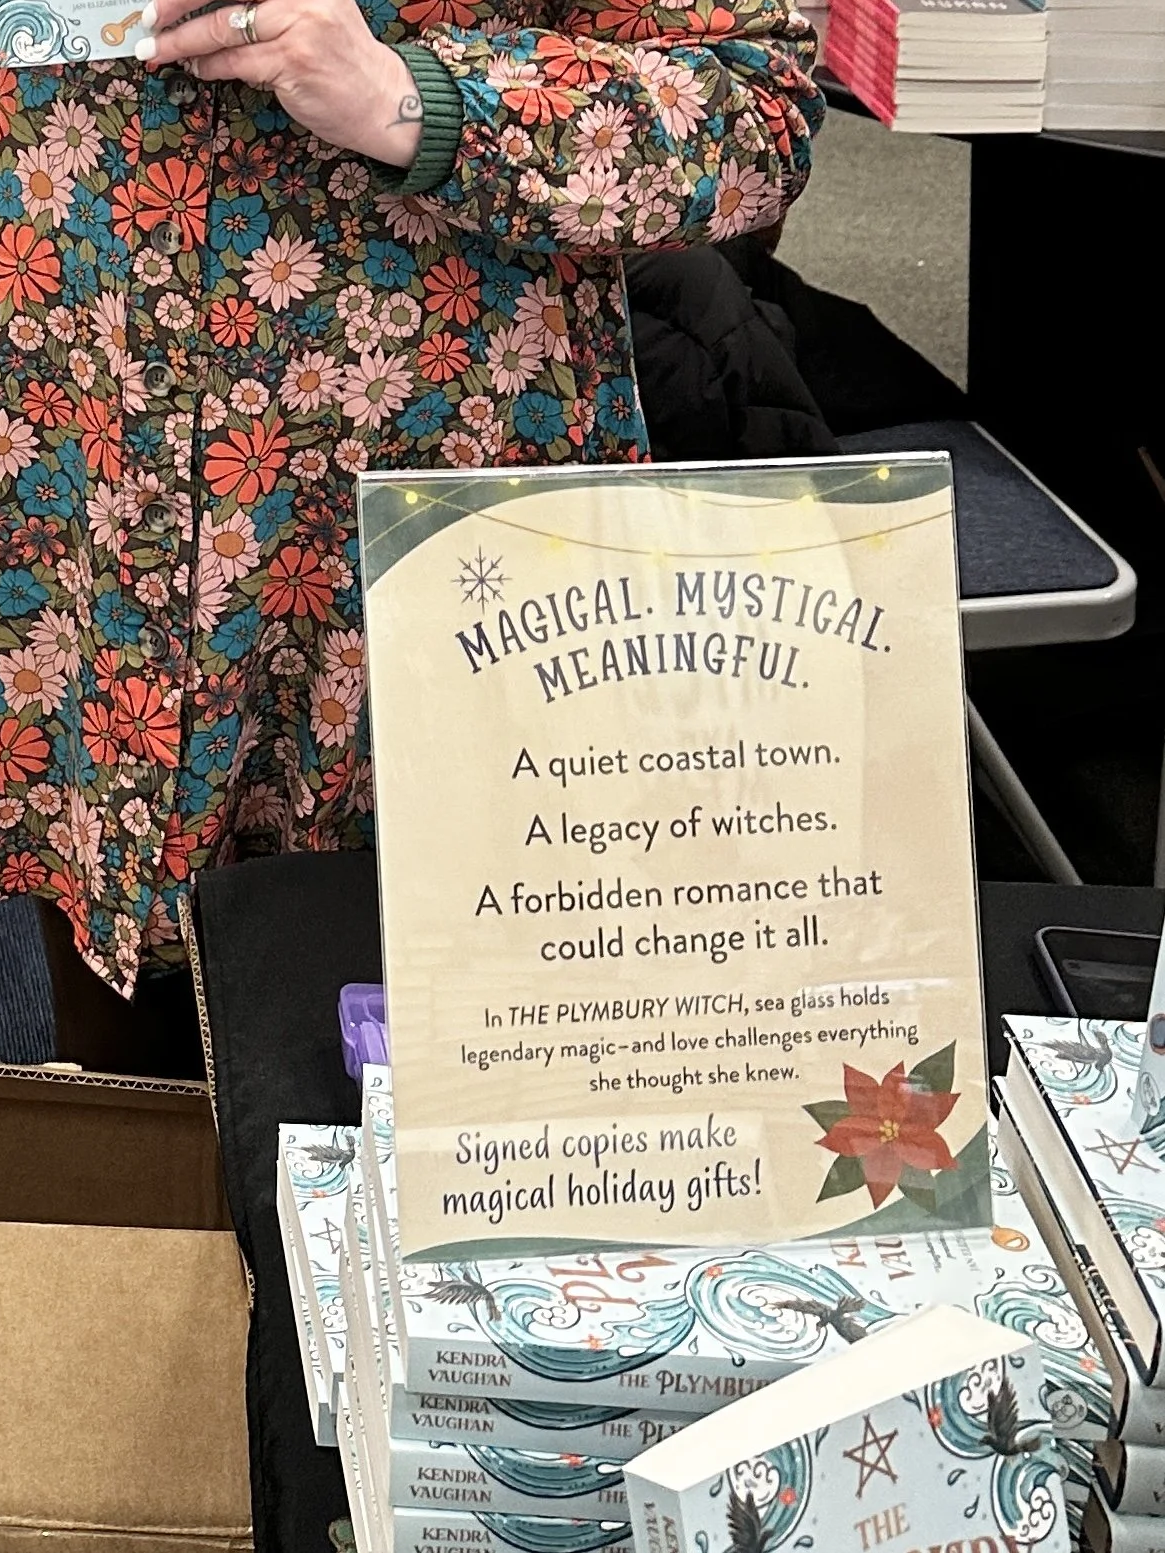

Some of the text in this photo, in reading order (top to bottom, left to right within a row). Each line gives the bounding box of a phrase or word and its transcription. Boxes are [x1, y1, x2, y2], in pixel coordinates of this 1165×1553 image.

[455, 570, 891, 674] MAGICAL. MYSTICAL.
[533, 632, 809, 703] MEANINGFUL.
[512, 740, 841, 788] A quiet coastal town.
[525, 801, 838, 854] A legacy of witches.
[475, 865, 883, 917] A forbidden romance that
[540, 915, 829, 965] could change it all.
[485, 985, 890, 1028] In THE PLYMBURY WITCH, sea glass holds
[461, 1041, 555, 1072] legendary
[671, 1026, 709, 1051] love
[714, 1019, 813, 1052] challenges
[816, 1011, 919, 1048] everything
[588, 1055, 800, 1094] she thought she knew.
[455, 1112, 737, 1175] Signed copies make
[442, 1157, 762, 1225] magical holiday gifts!
[428, 1369, 512, 1388] VAUGHAN
[436, 1350, 507, 1369] KENDRA
[419, 1396, 491, 1415] KENDRA
[618, 1370, 774, 1398] THE PLYMBU
[411, 1413, 495, 1433] VAUGHAN
[601, 1423, 632, 1438] THE
[409, 1485, 493, 1504] VAUGHAN
[417, 1466, 488, 1485] KENDRA
[422, 1526, 492, 1545] KENDRA
[854, 1502, 911, 1552] THE
